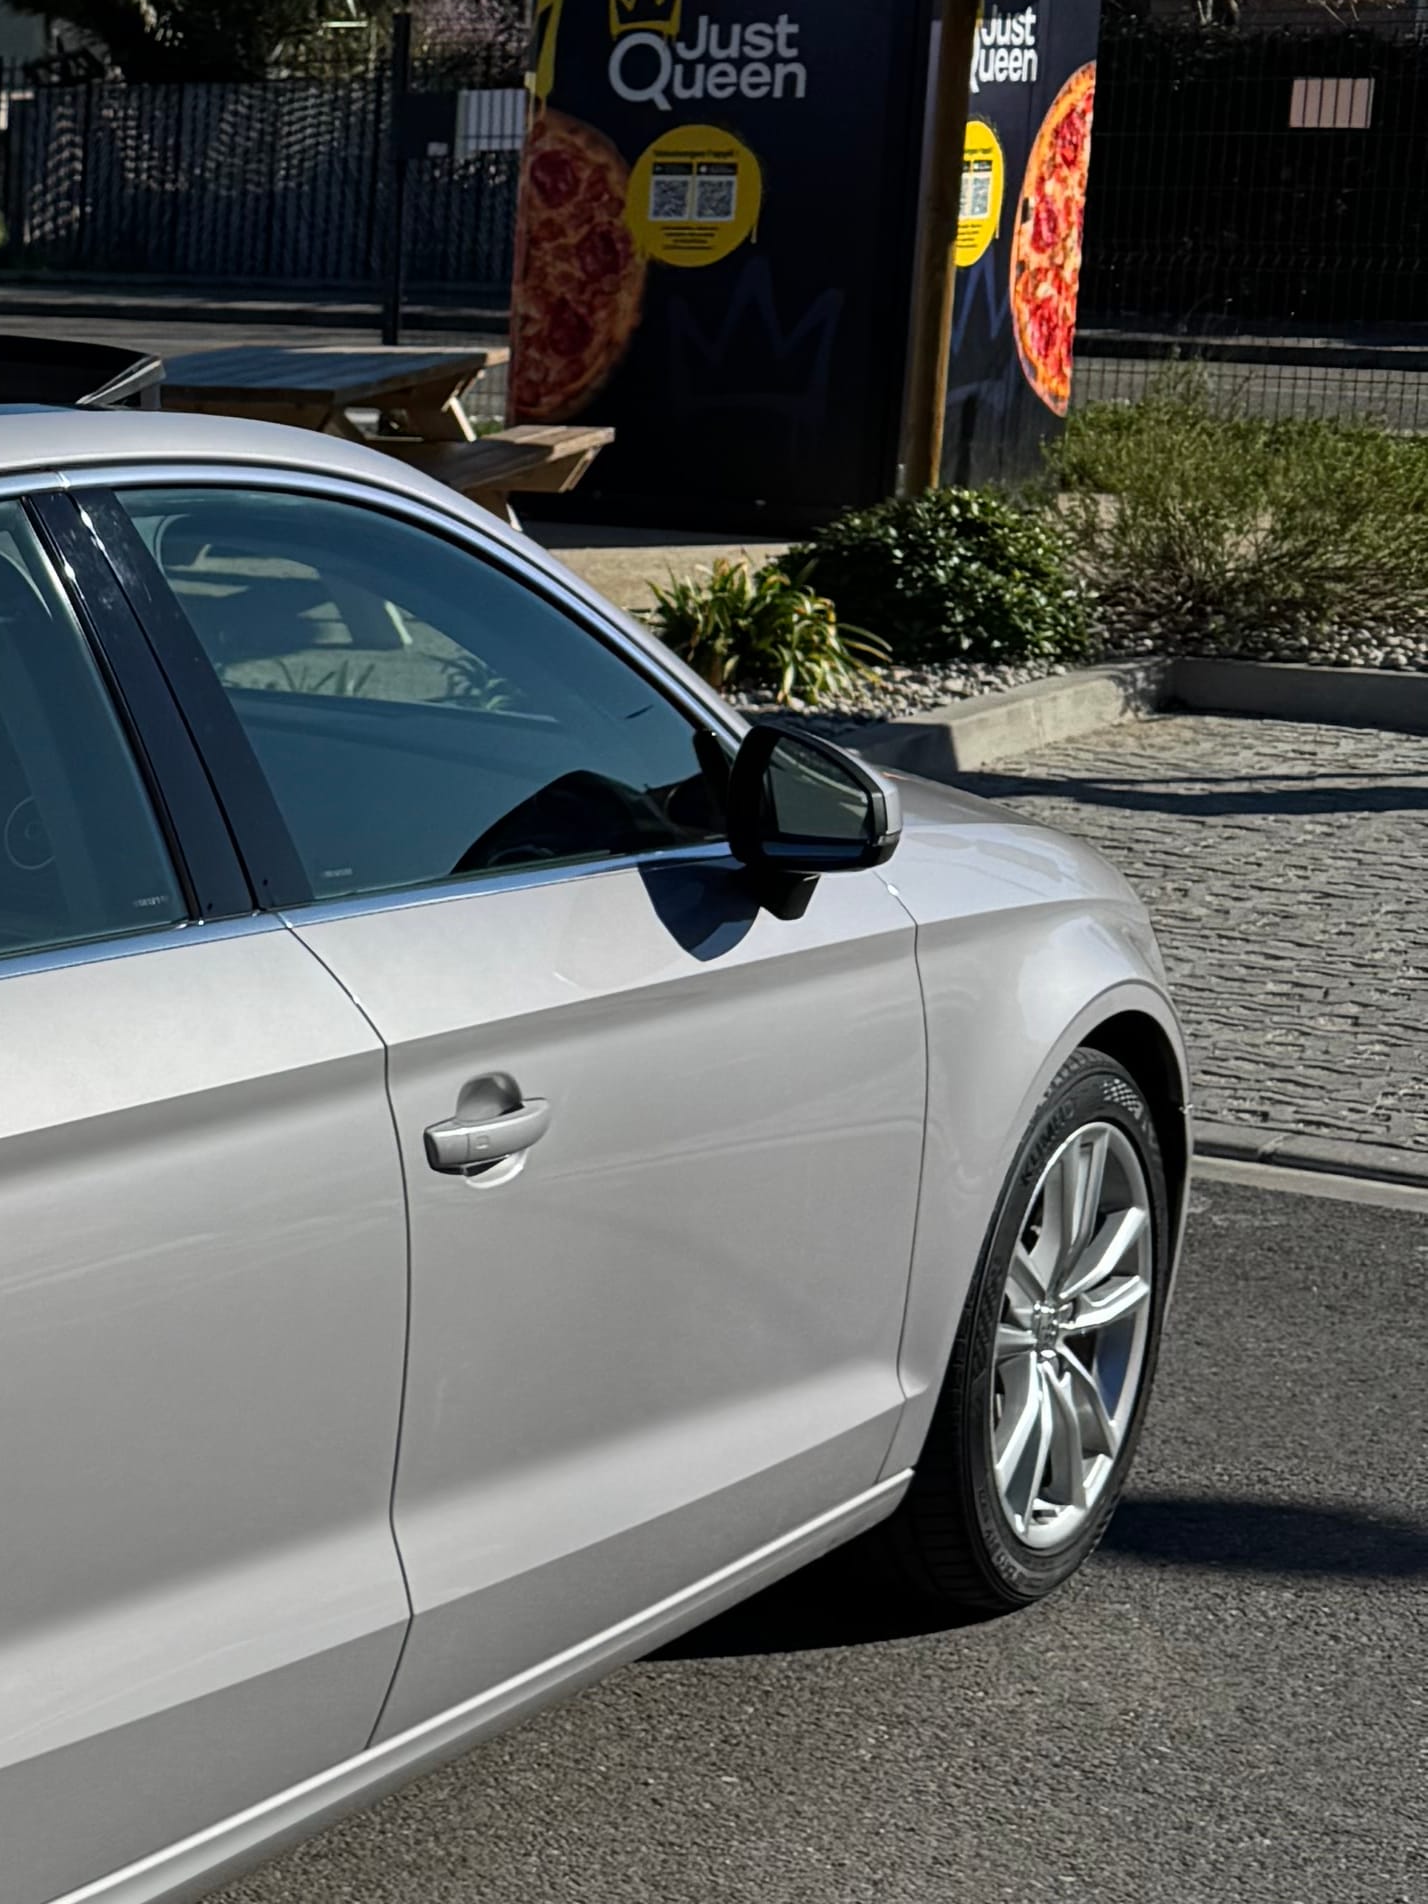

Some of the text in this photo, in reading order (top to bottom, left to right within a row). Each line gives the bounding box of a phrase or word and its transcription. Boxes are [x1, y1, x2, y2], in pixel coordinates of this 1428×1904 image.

[675, 13, 800, 61] Just
[981, 4, 1037, 47] Just
[607, 31, 808, 112] Queen
